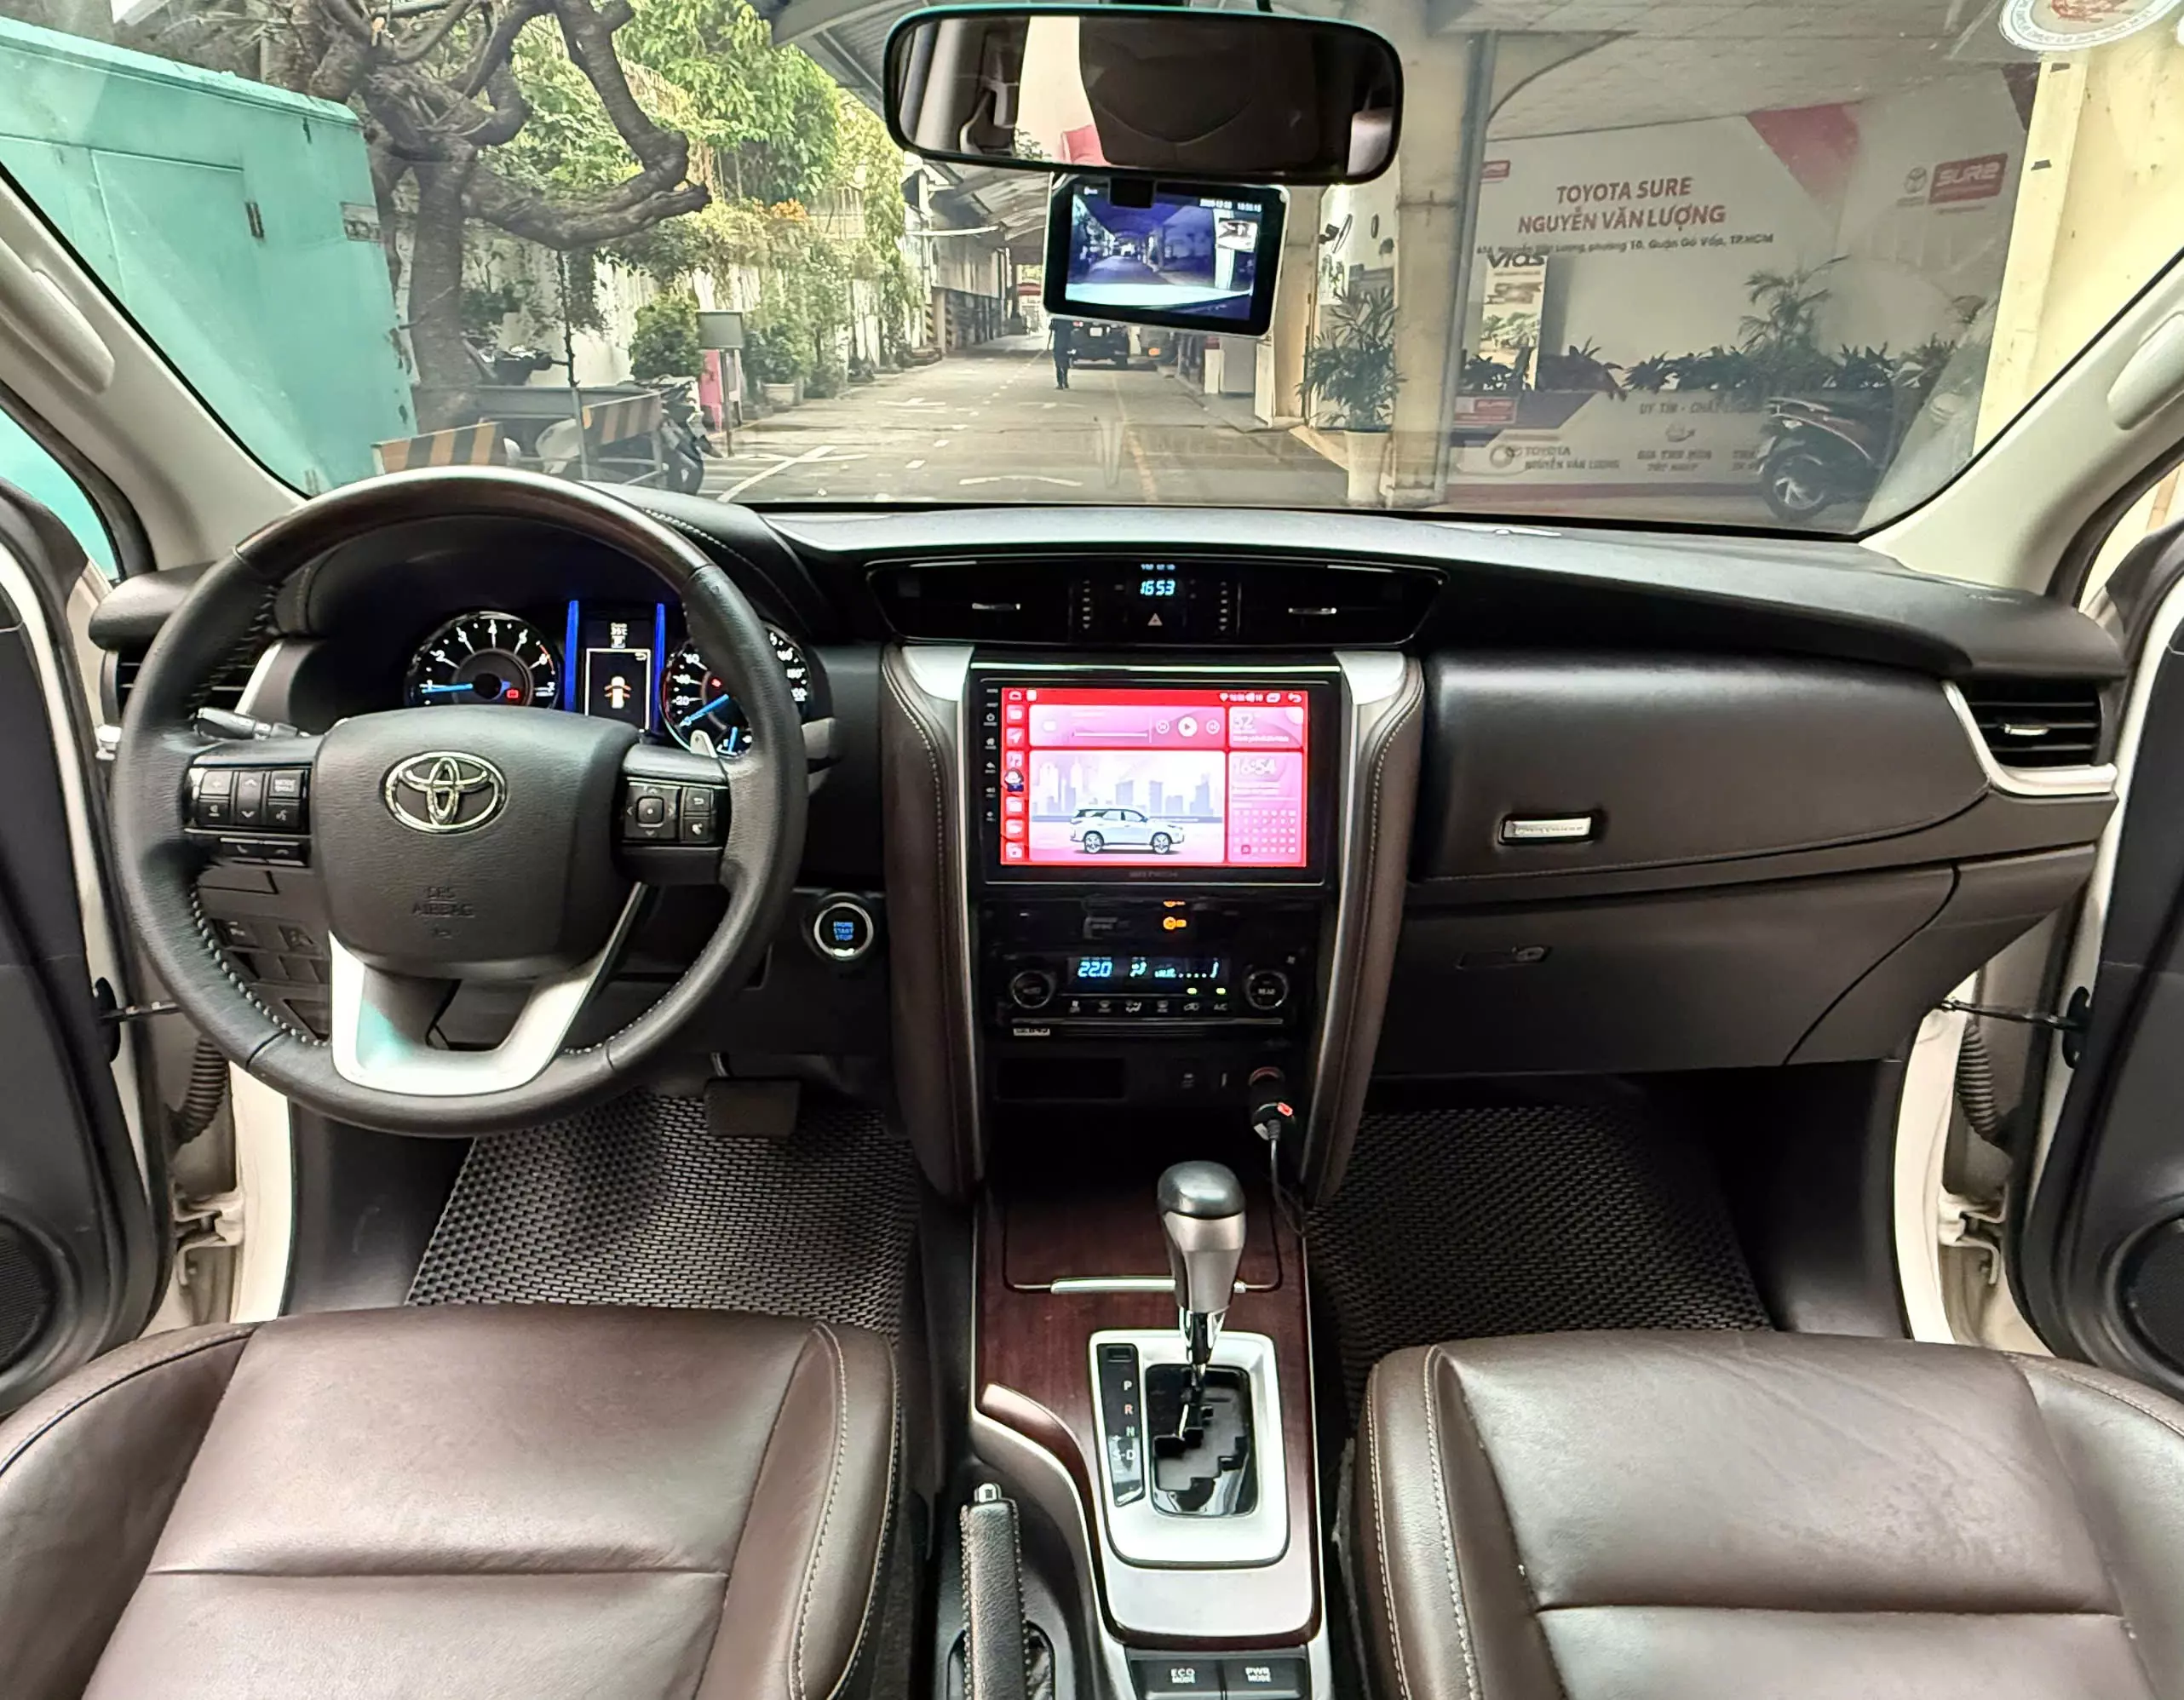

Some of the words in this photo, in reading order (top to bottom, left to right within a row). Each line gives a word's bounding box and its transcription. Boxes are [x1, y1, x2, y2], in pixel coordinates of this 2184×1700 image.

[1556, 181, 1631, 204] TOYOTA
[1636, 176, 1693, 198] SURE
[1518, 206, 1597, 234] NGUYỄN
[1601, 206, 1643, 230] VĂN
[1647, 204, 1726, 231] LƯỢNG
[457, 630, 468, 643] 3
[519, 632, 528, 644] 5
[435, 650, 445, 662] 2
[1124, 1380, 1133, 1391] P
[1124, 1403, 1134, 1415] R
[1125, 1425, 1135, 1437] N
[1170, 1668, 1195, 1677] ECO
